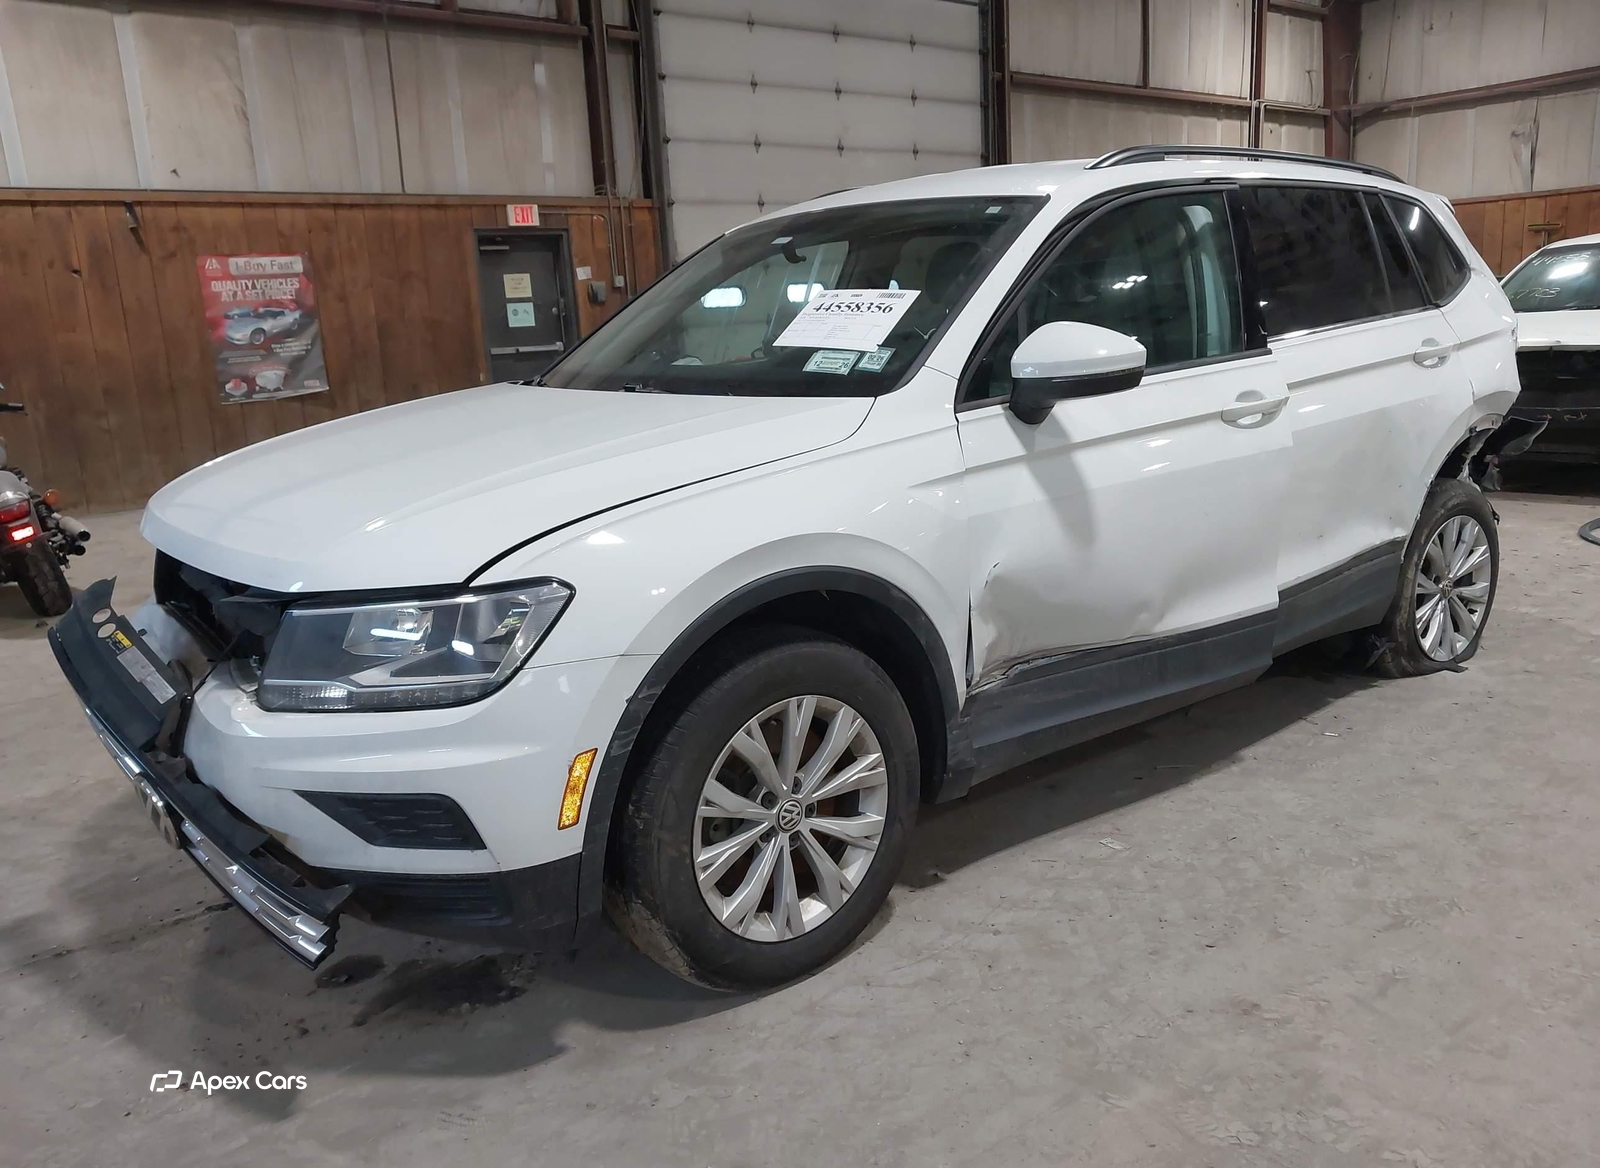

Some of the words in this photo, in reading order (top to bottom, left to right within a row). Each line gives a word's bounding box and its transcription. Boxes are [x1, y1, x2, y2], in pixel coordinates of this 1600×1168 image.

[513, 205, 534, 223] EXIT
[235, 261, 267, 272] I-Buy
[270, 260, 295, 270] Fast
[211, 279, 256, 292] QUALITY
[255, 278, 300, 290] VEHICLES
[221, 290, 237, 302] AT
[237, 289, 244, 301] A
[245, 289, 264, 300] SET
[812, 301, 898, 314] 44558356
